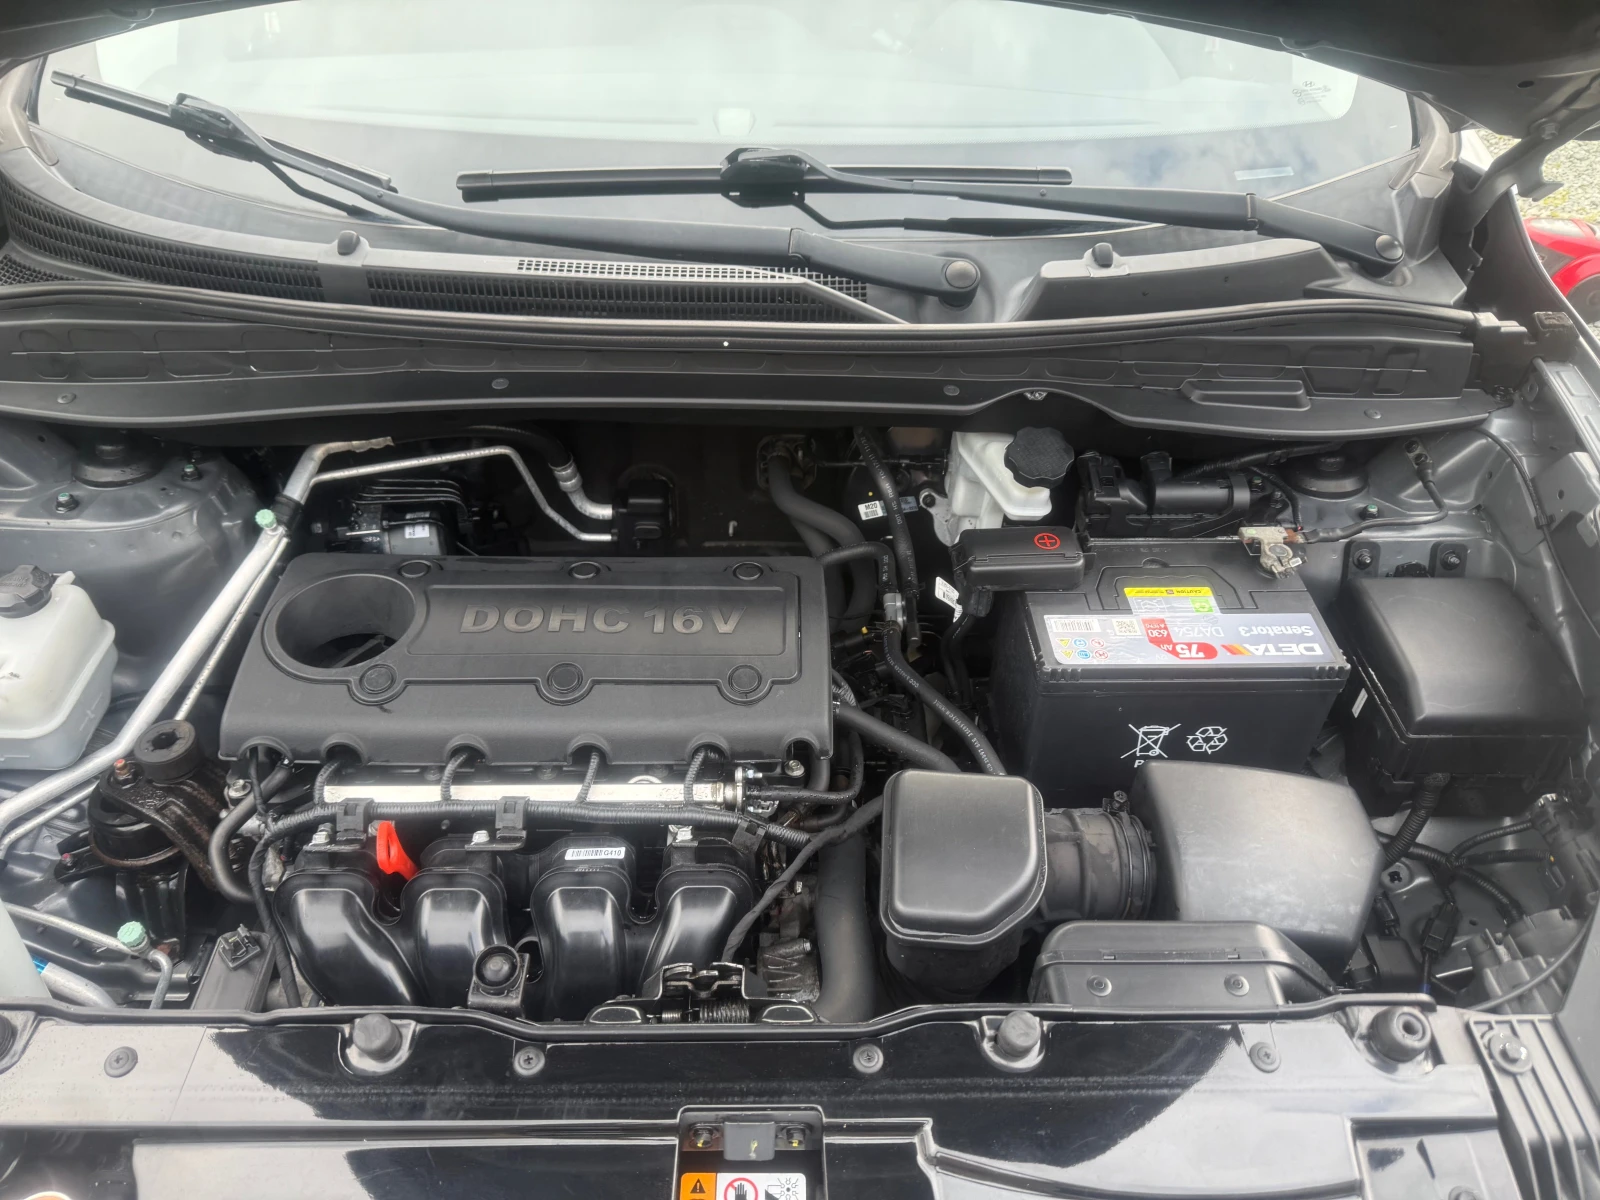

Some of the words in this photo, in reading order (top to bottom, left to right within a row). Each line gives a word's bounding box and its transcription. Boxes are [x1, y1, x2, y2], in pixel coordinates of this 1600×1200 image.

[460, 604, 630, 633] DOHC
[644, 604, 746, 634] 16V
[1147, 629, 1168, 638] 630
[1172, 626, 1225, 637] DA754
[1238, 625, 1314, 637] Senator3
[1175, 643, 1205, 658] 75
[1242, 643, 1324, 656] DETA
[603, 849, 622, 857] G410
